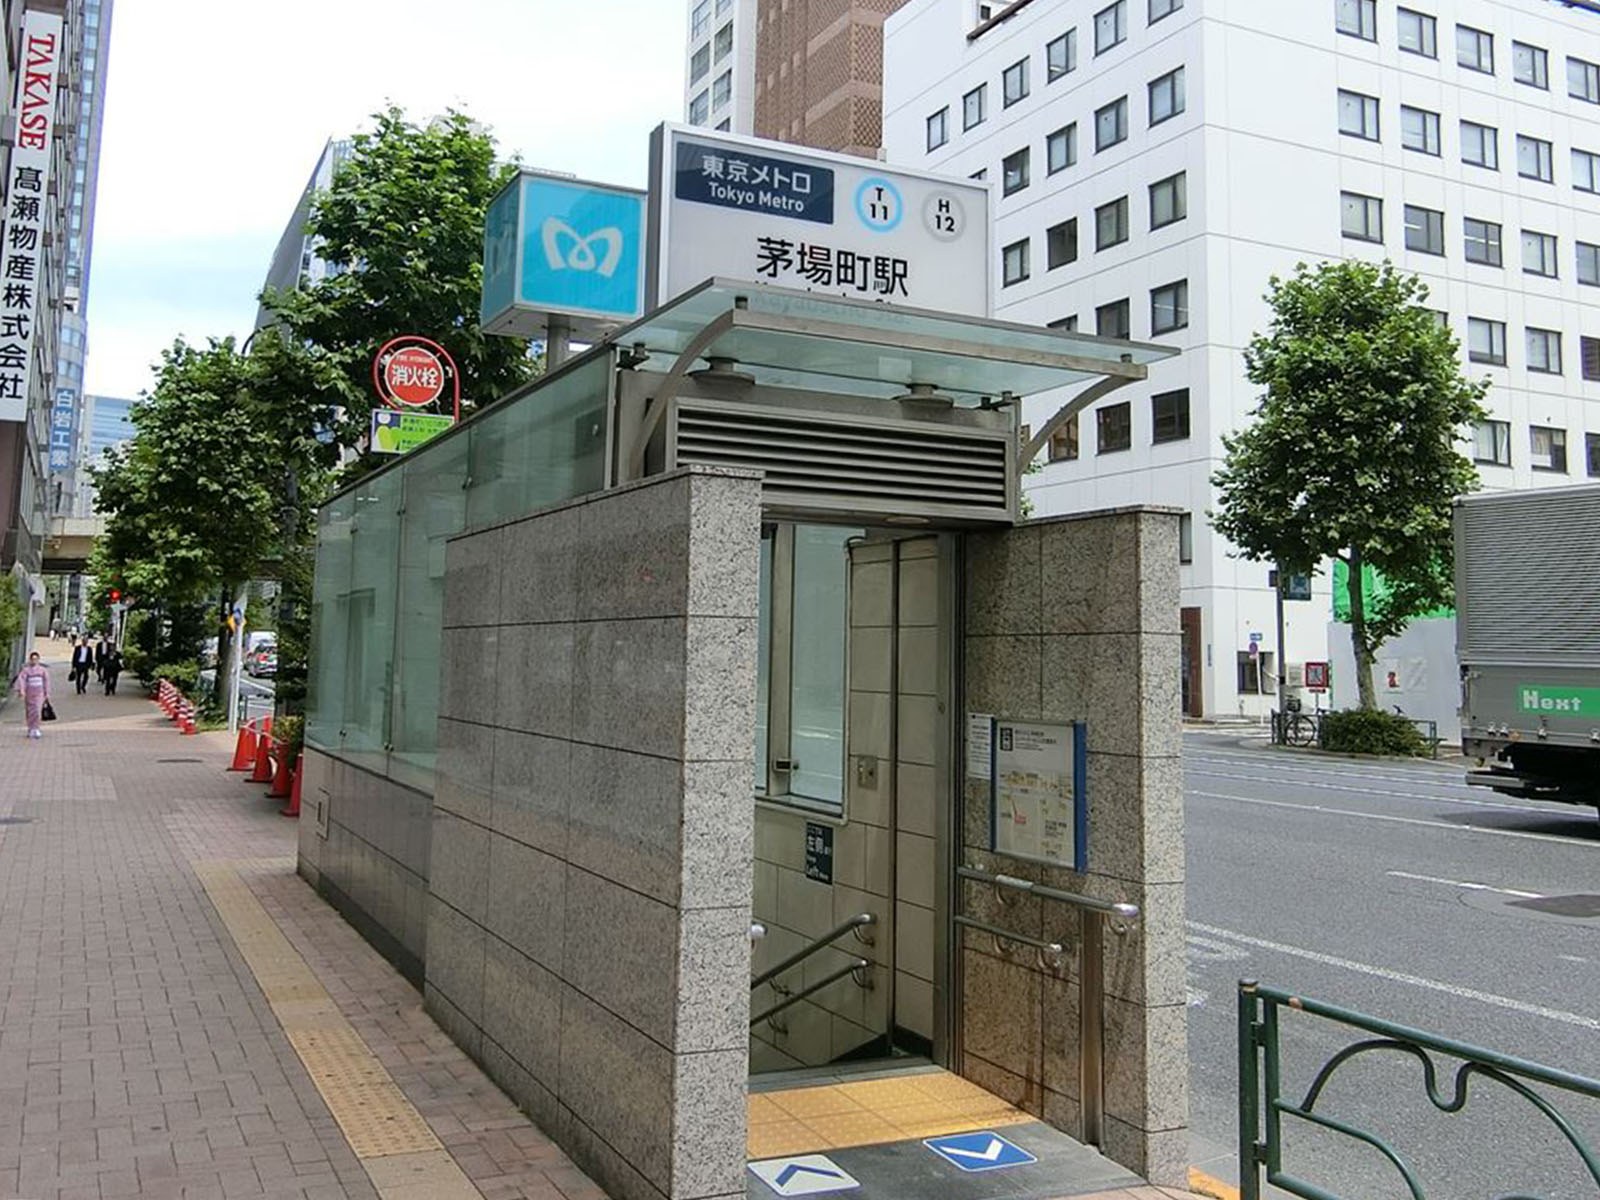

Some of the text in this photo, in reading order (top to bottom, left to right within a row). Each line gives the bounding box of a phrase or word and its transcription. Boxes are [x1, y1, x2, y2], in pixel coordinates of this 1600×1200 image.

[18, 33, 55, 150] TAKASE
[701, 155, 811, 194] 東京メトロ
[708, 181, 805, 214] Tokyo Metro
[875, 187, 884, 201] T
[938, 198, 950, 214] H
[869, 203, 889, 221] 11
[935, 215, 955, 233] 12
[756, 236, 909, 297] 茅場町駅
[391, 363, 439, 389] 消火栓
